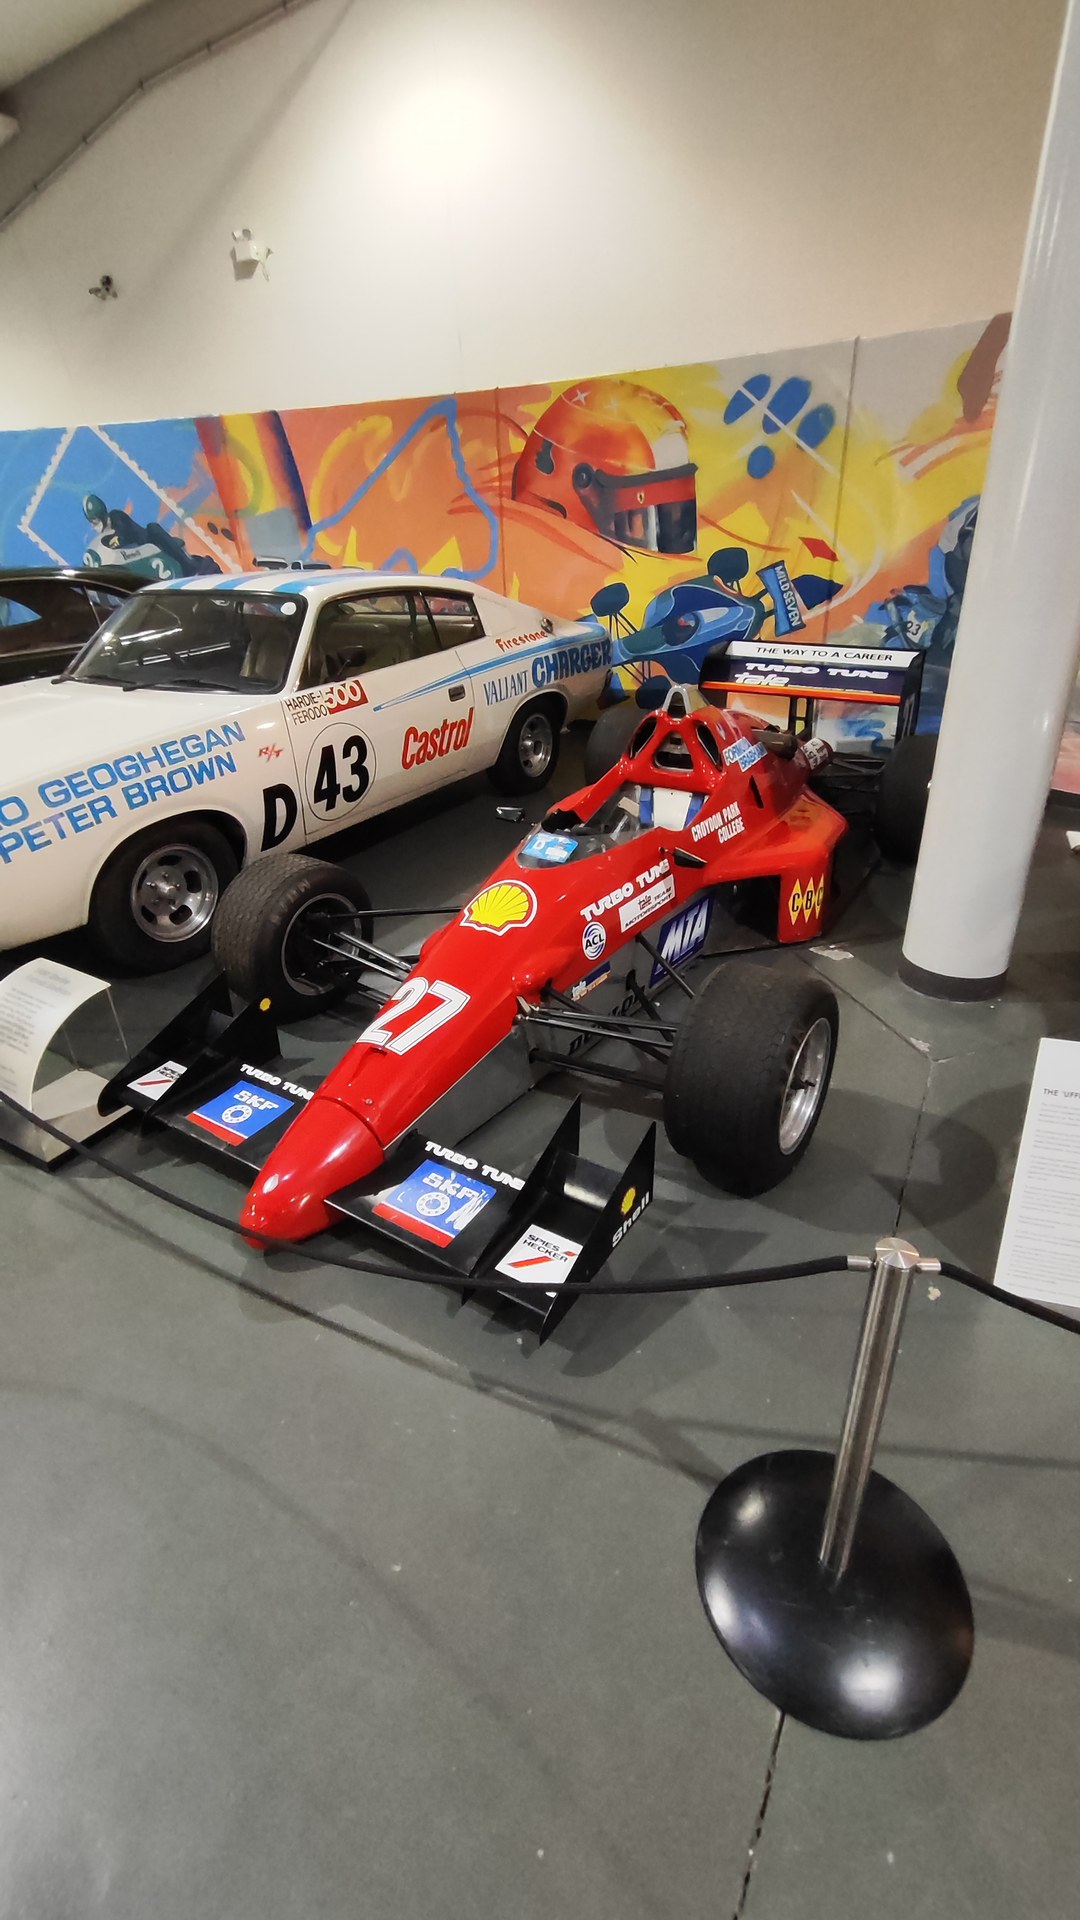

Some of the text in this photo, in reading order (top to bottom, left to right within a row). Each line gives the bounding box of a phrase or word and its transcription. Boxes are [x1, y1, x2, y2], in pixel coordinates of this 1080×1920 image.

[151, 559, 172, 580] 2
[775, 565, 801, 627] MILD SEVEN
[495, 629, 548, 652] Firestone
[756, 646, 779, 655] THE
[782, 648, 808, 656] WAY
[811, 649, 828, 657] TO
[844, 652, 893, 662] CAREER
[483, 638, 613, 706] VALIANT CHARGER
[745, 663, 889, 680] TURBO TUNE
[323, 681, 362, 709] 500
[291, 704, 328, 726] FERODO
[401, 707, 474, 770] Castrol
[0, 721, 246, 828] O GEOGHEGAN
[313, 734, 370, 812] 43
[0, 752, 238, 865] PETER BROWN
[261, 783, 298, 852] D
[691, 801, 741, 842] CROYDON PARK
[718, 817, 745, 844] COLLEGE
[580, 858, 670, 922] TURBO TUNE
[584, 932, 605, 951] ACL
[356, 976, 472, 1056] 27
[240, 1063, 282, 1086] TURBO
[233, 1090, 280, 1111] SKF
[1063, 1091, 1080, 1100] 'UFF
[425, 1141, 526, 1191] TURBO TUNE
[612, 1191, 650, 1249] Shell
[522, 1239, 569, 1263] HECKER
[527, 1233, 561, 1253] SPIES
